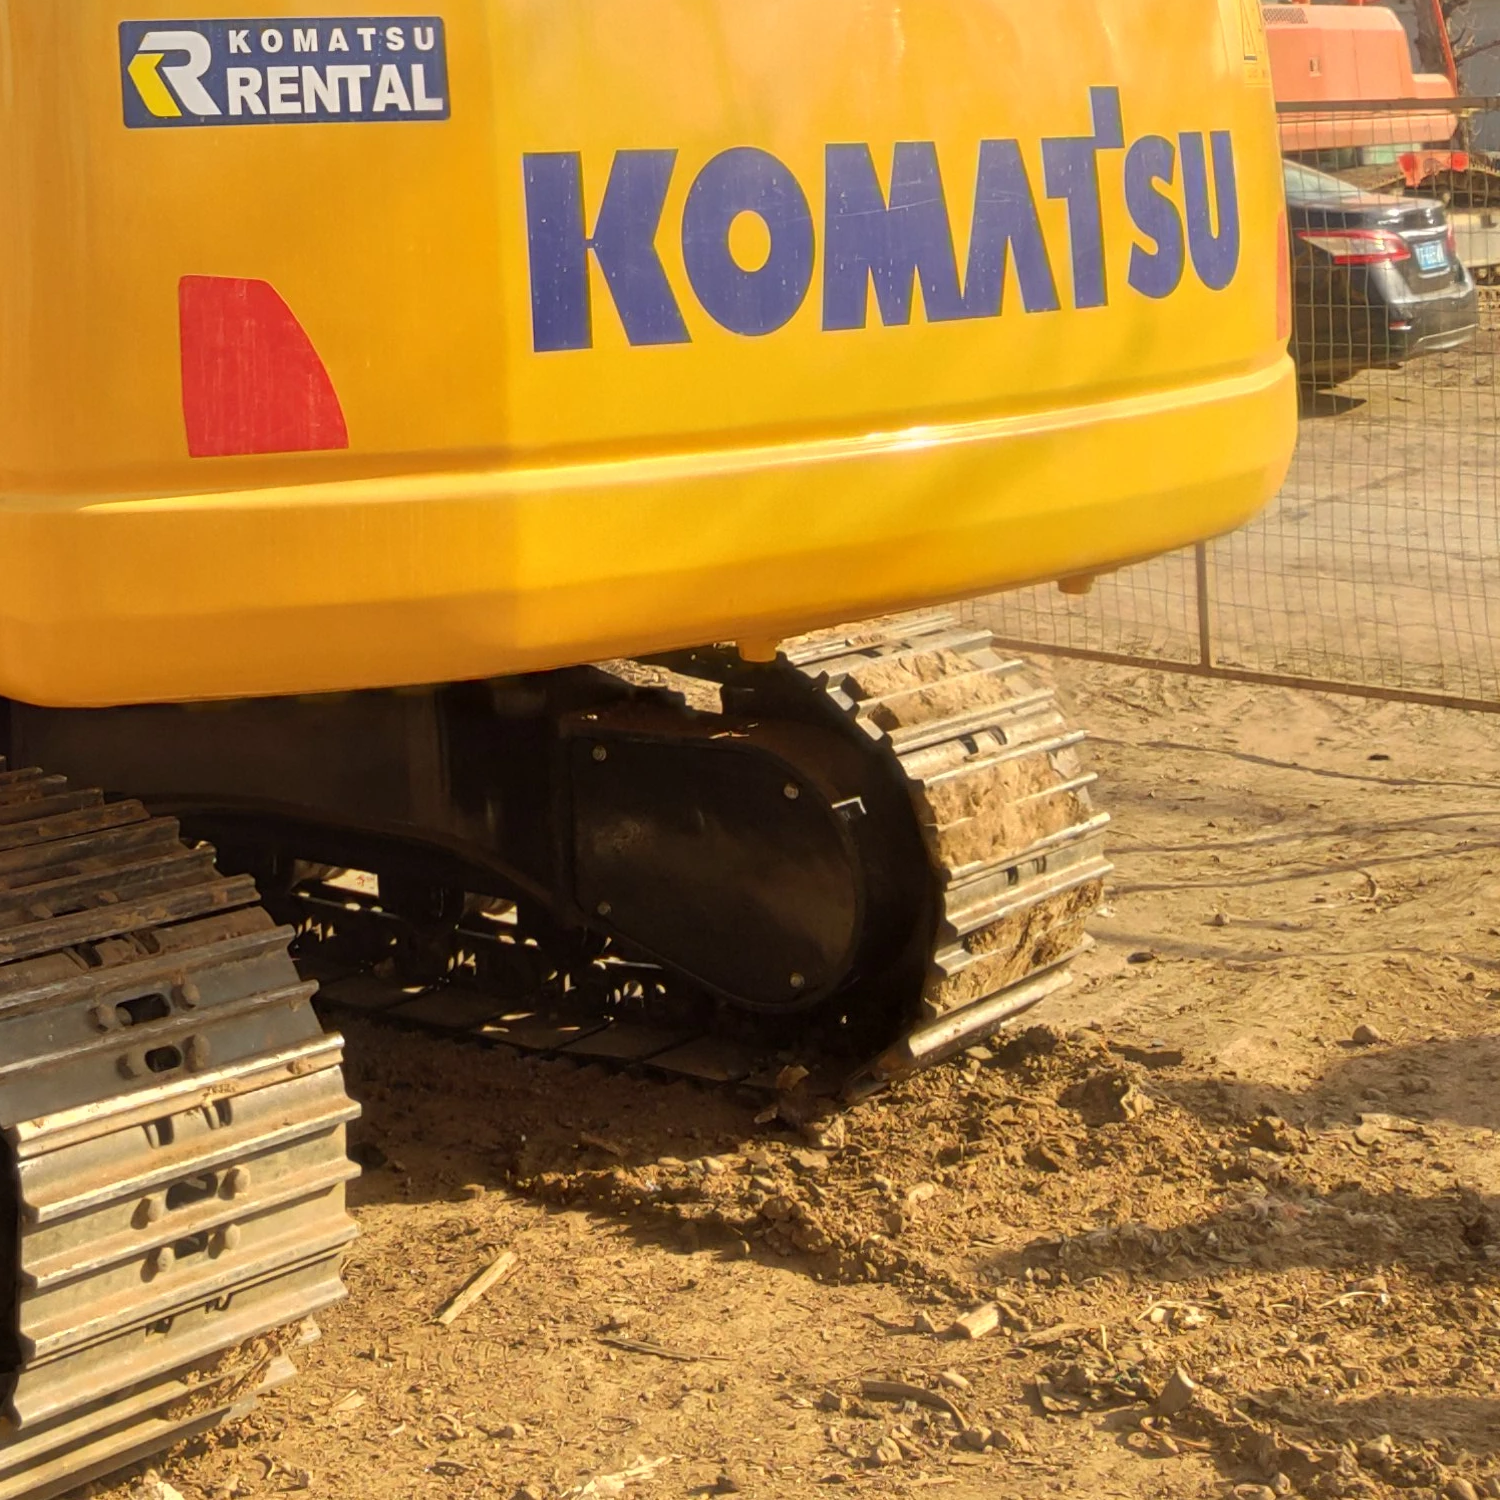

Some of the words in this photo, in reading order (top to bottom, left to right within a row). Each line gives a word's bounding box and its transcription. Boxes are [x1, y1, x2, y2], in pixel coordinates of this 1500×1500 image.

[228, 27, 435, 54] KOMATSU
[226, 64, 444, 116] RENTAL
[522, 85, 1241, 353] KOMATSU
